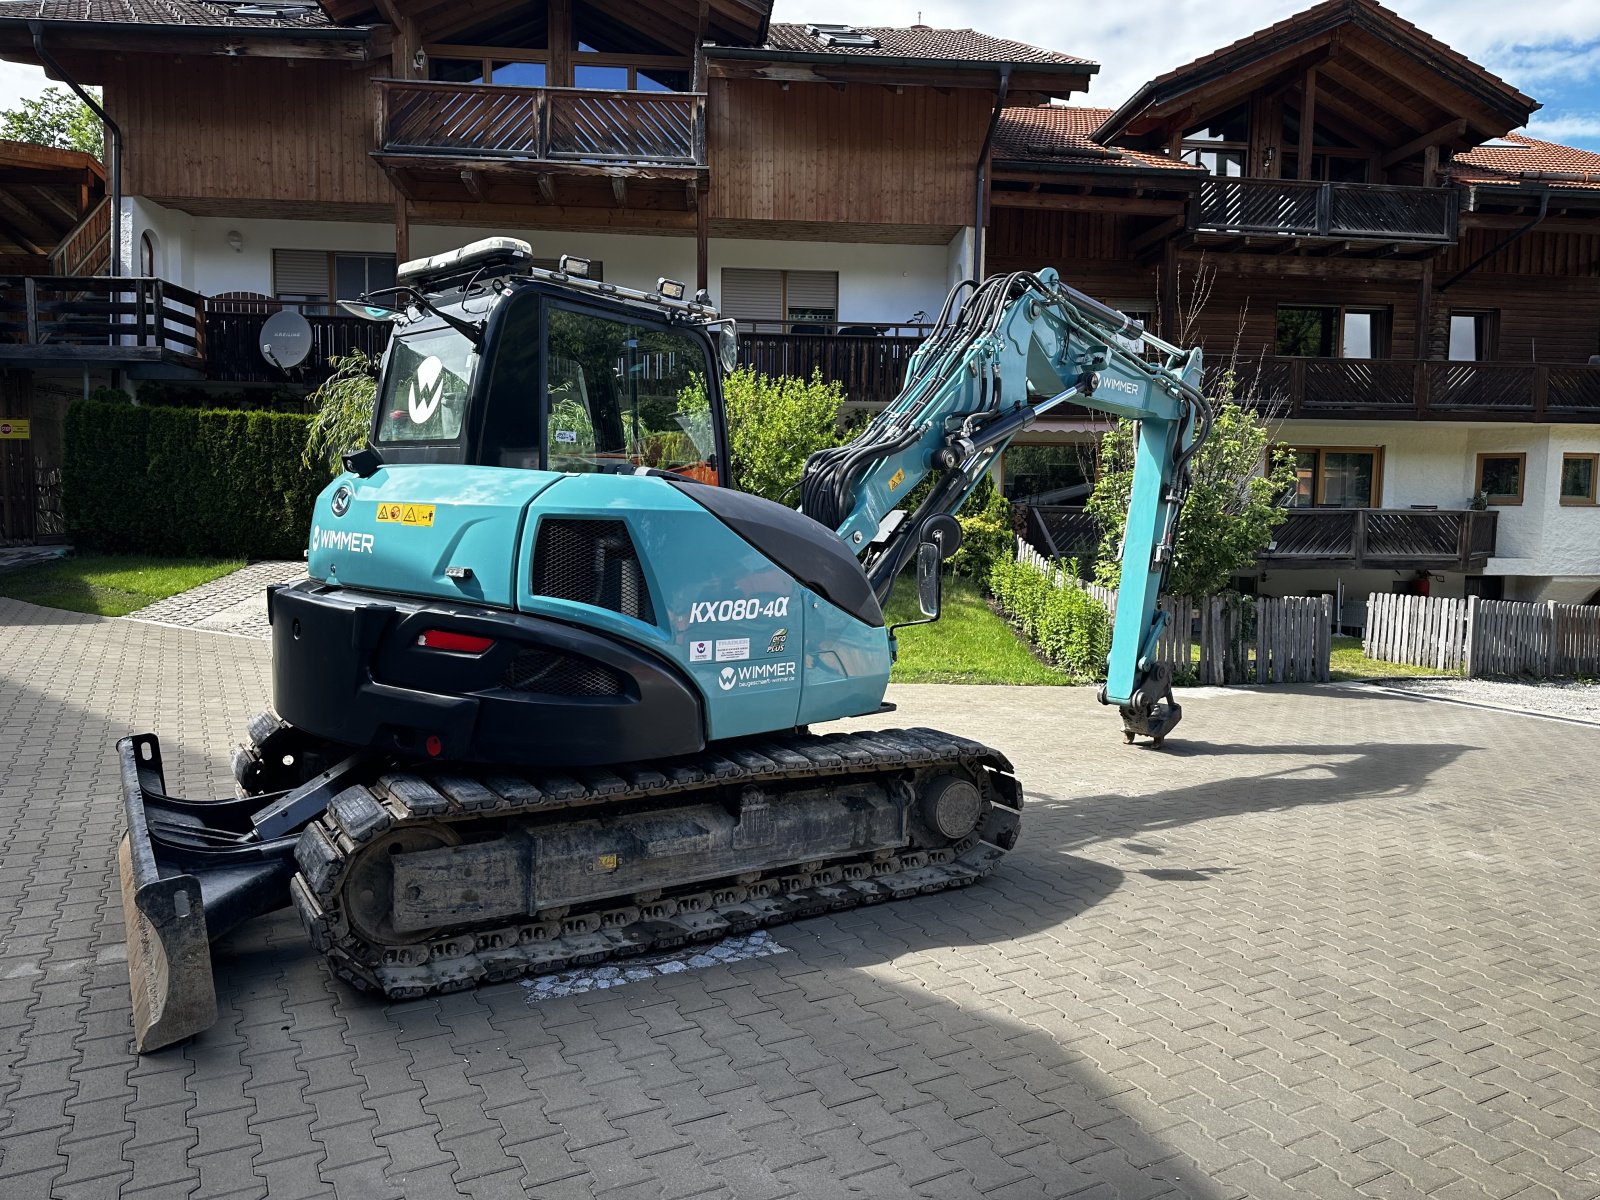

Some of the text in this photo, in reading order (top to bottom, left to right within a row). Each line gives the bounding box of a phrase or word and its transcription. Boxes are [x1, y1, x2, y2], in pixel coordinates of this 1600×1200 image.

[1103, 377, 1139, 396] WIMMER
[320, 529, 375, 554] WIMMER
[766, 645, 785, 653] PLUS
[738, 661, 796, 680] WIMMER
